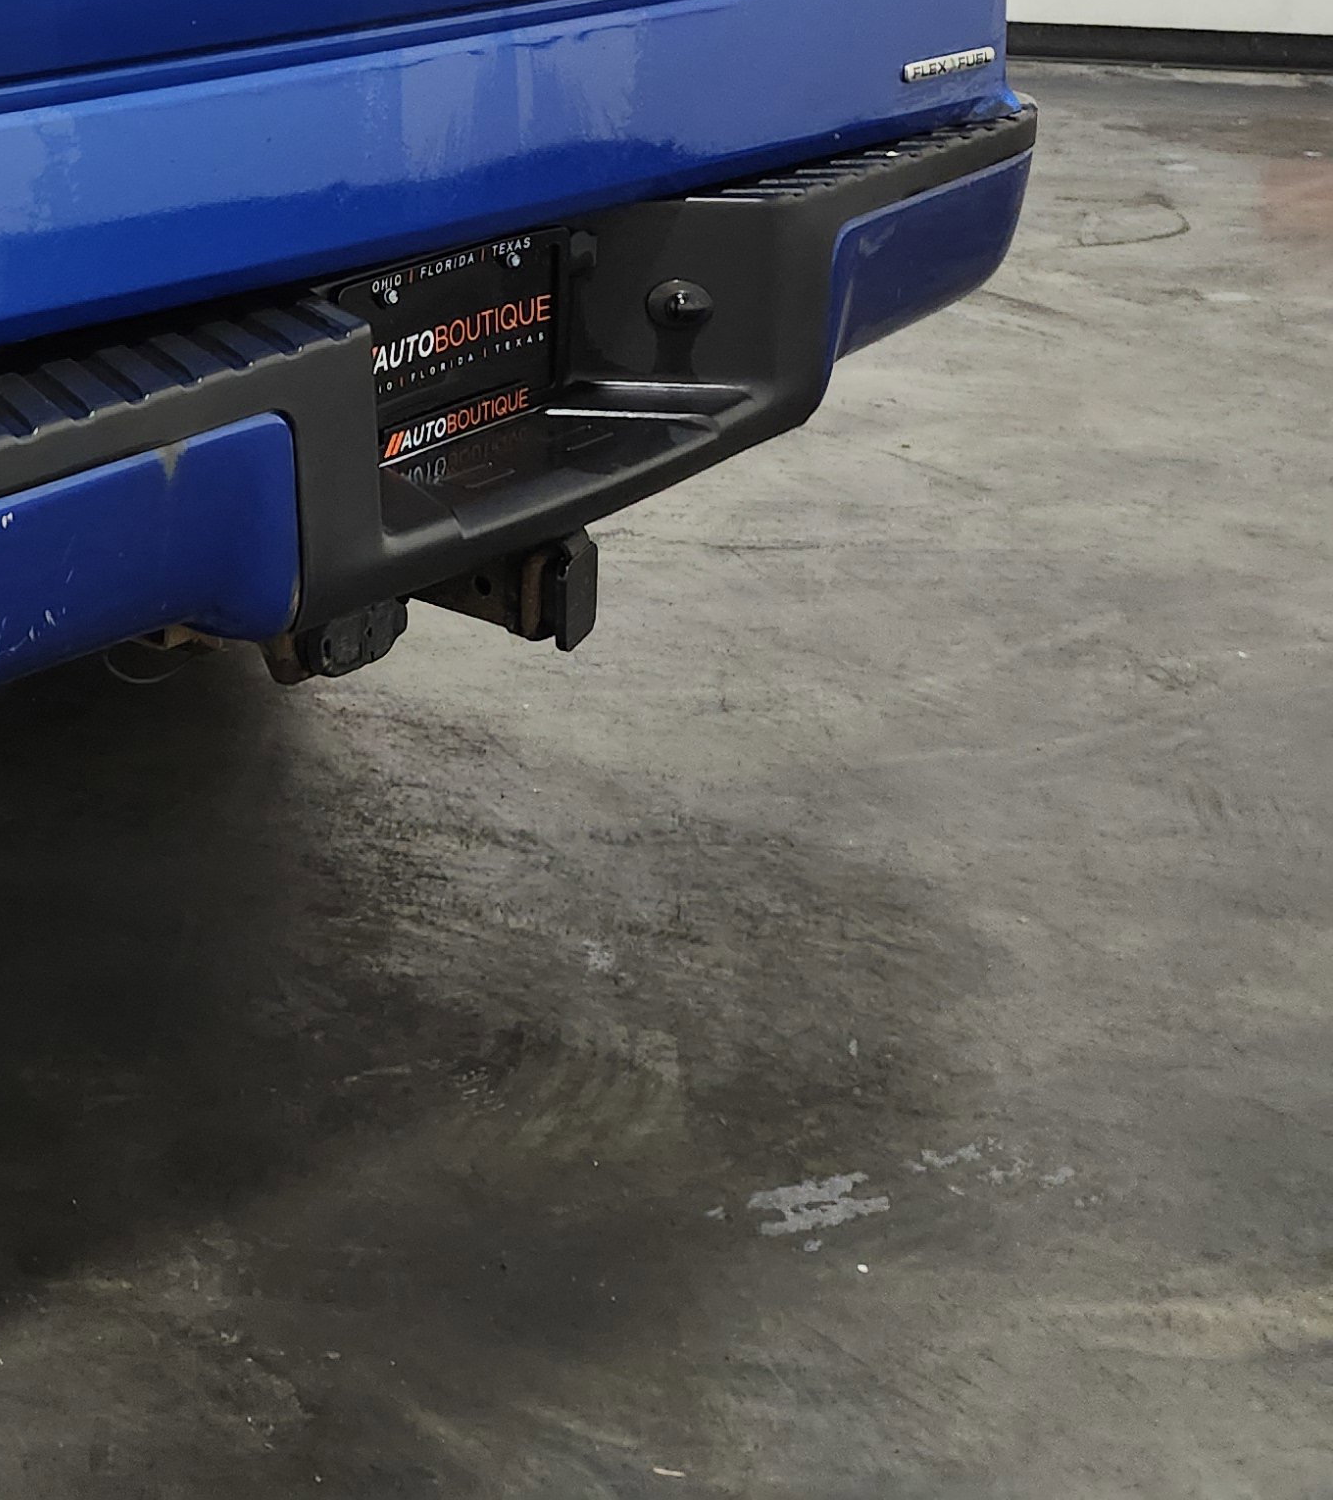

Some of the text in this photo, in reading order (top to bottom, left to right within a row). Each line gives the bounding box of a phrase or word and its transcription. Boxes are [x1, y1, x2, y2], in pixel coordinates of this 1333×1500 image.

[912, 51, 992, 79] FLEX FUEL
[372, 236, 531, 294] OHIO FLORIDA TEXAS
[372, 294, 552, 376] AUTOBOUTIQUE
[410, 353, 474, 383] FLORIDA
[494, 331, 545, 354] TEXAS
[400, 387, 530, 452] AUTOBOUTIQUE
